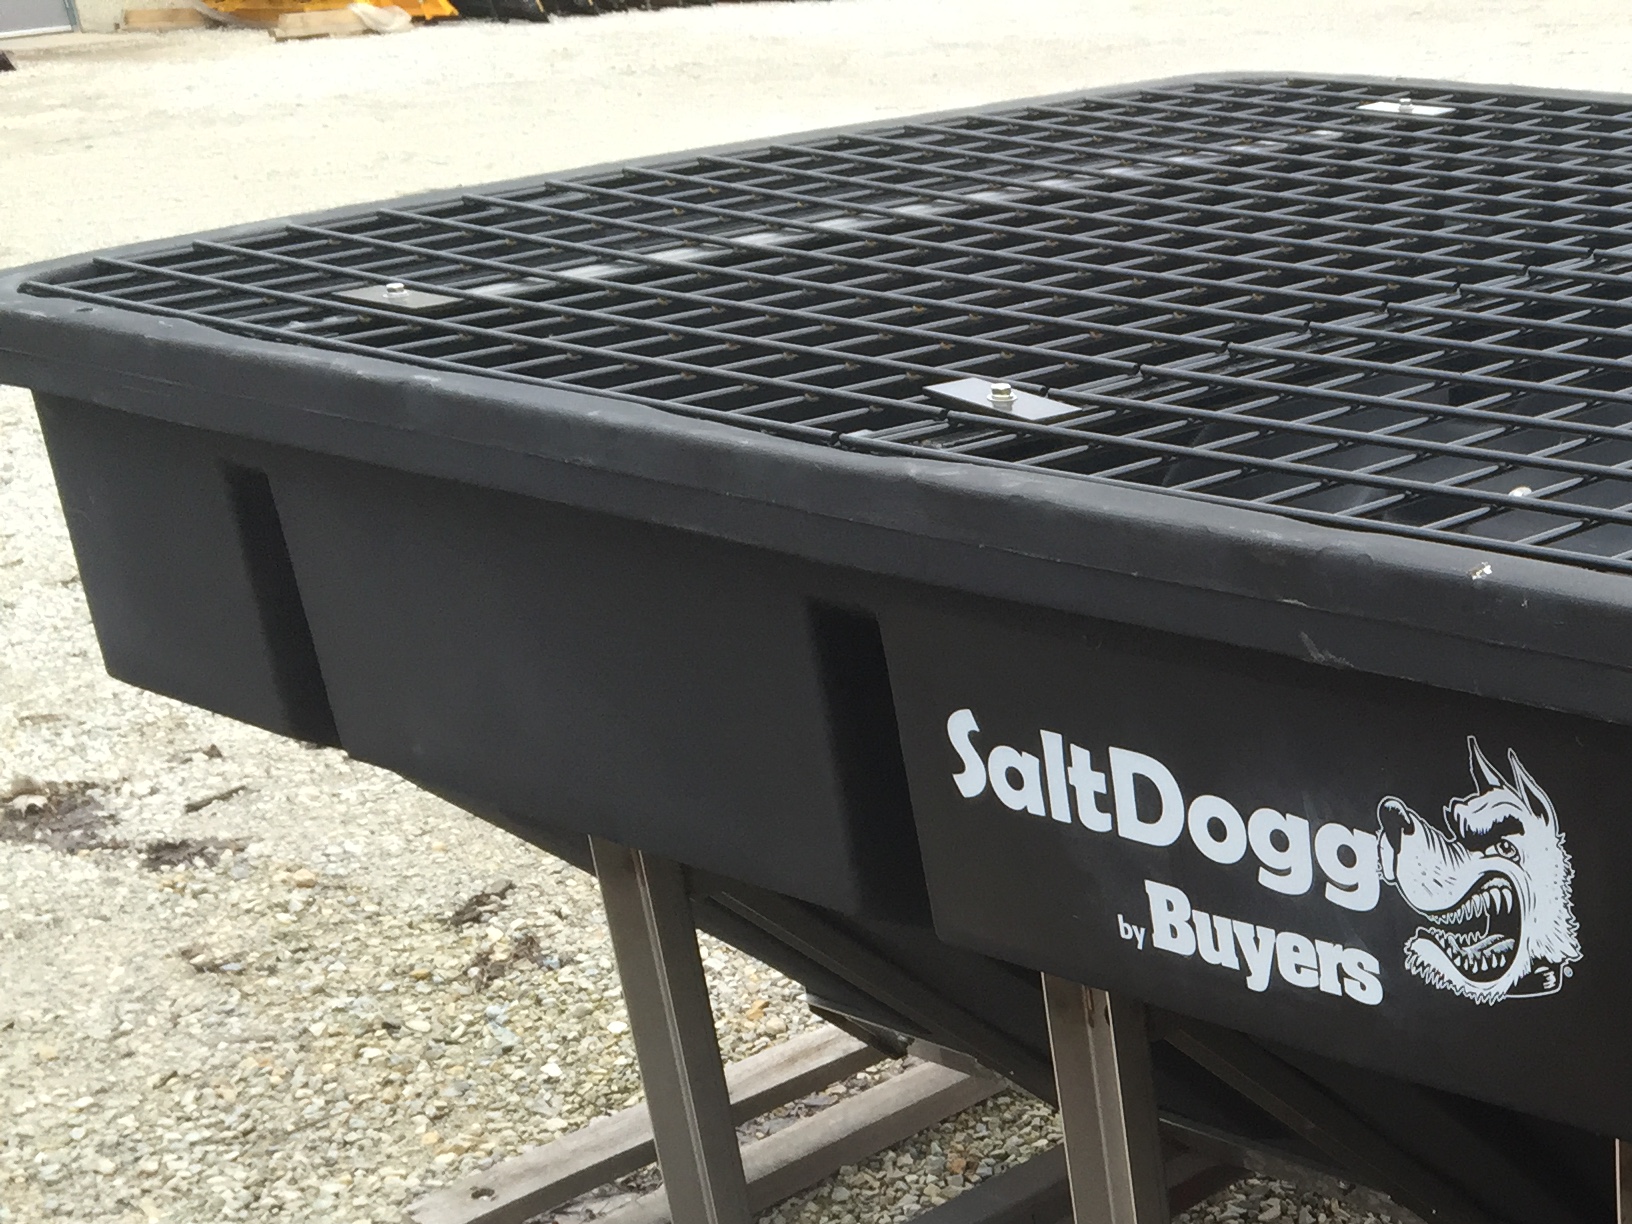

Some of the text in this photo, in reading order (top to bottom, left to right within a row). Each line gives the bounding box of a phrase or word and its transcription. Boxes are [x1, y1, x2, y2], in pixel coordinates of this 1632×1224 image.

[947, 709, 1383, 912] SaltDogg
[1118, 880, 1384, 1005] by Buyers
